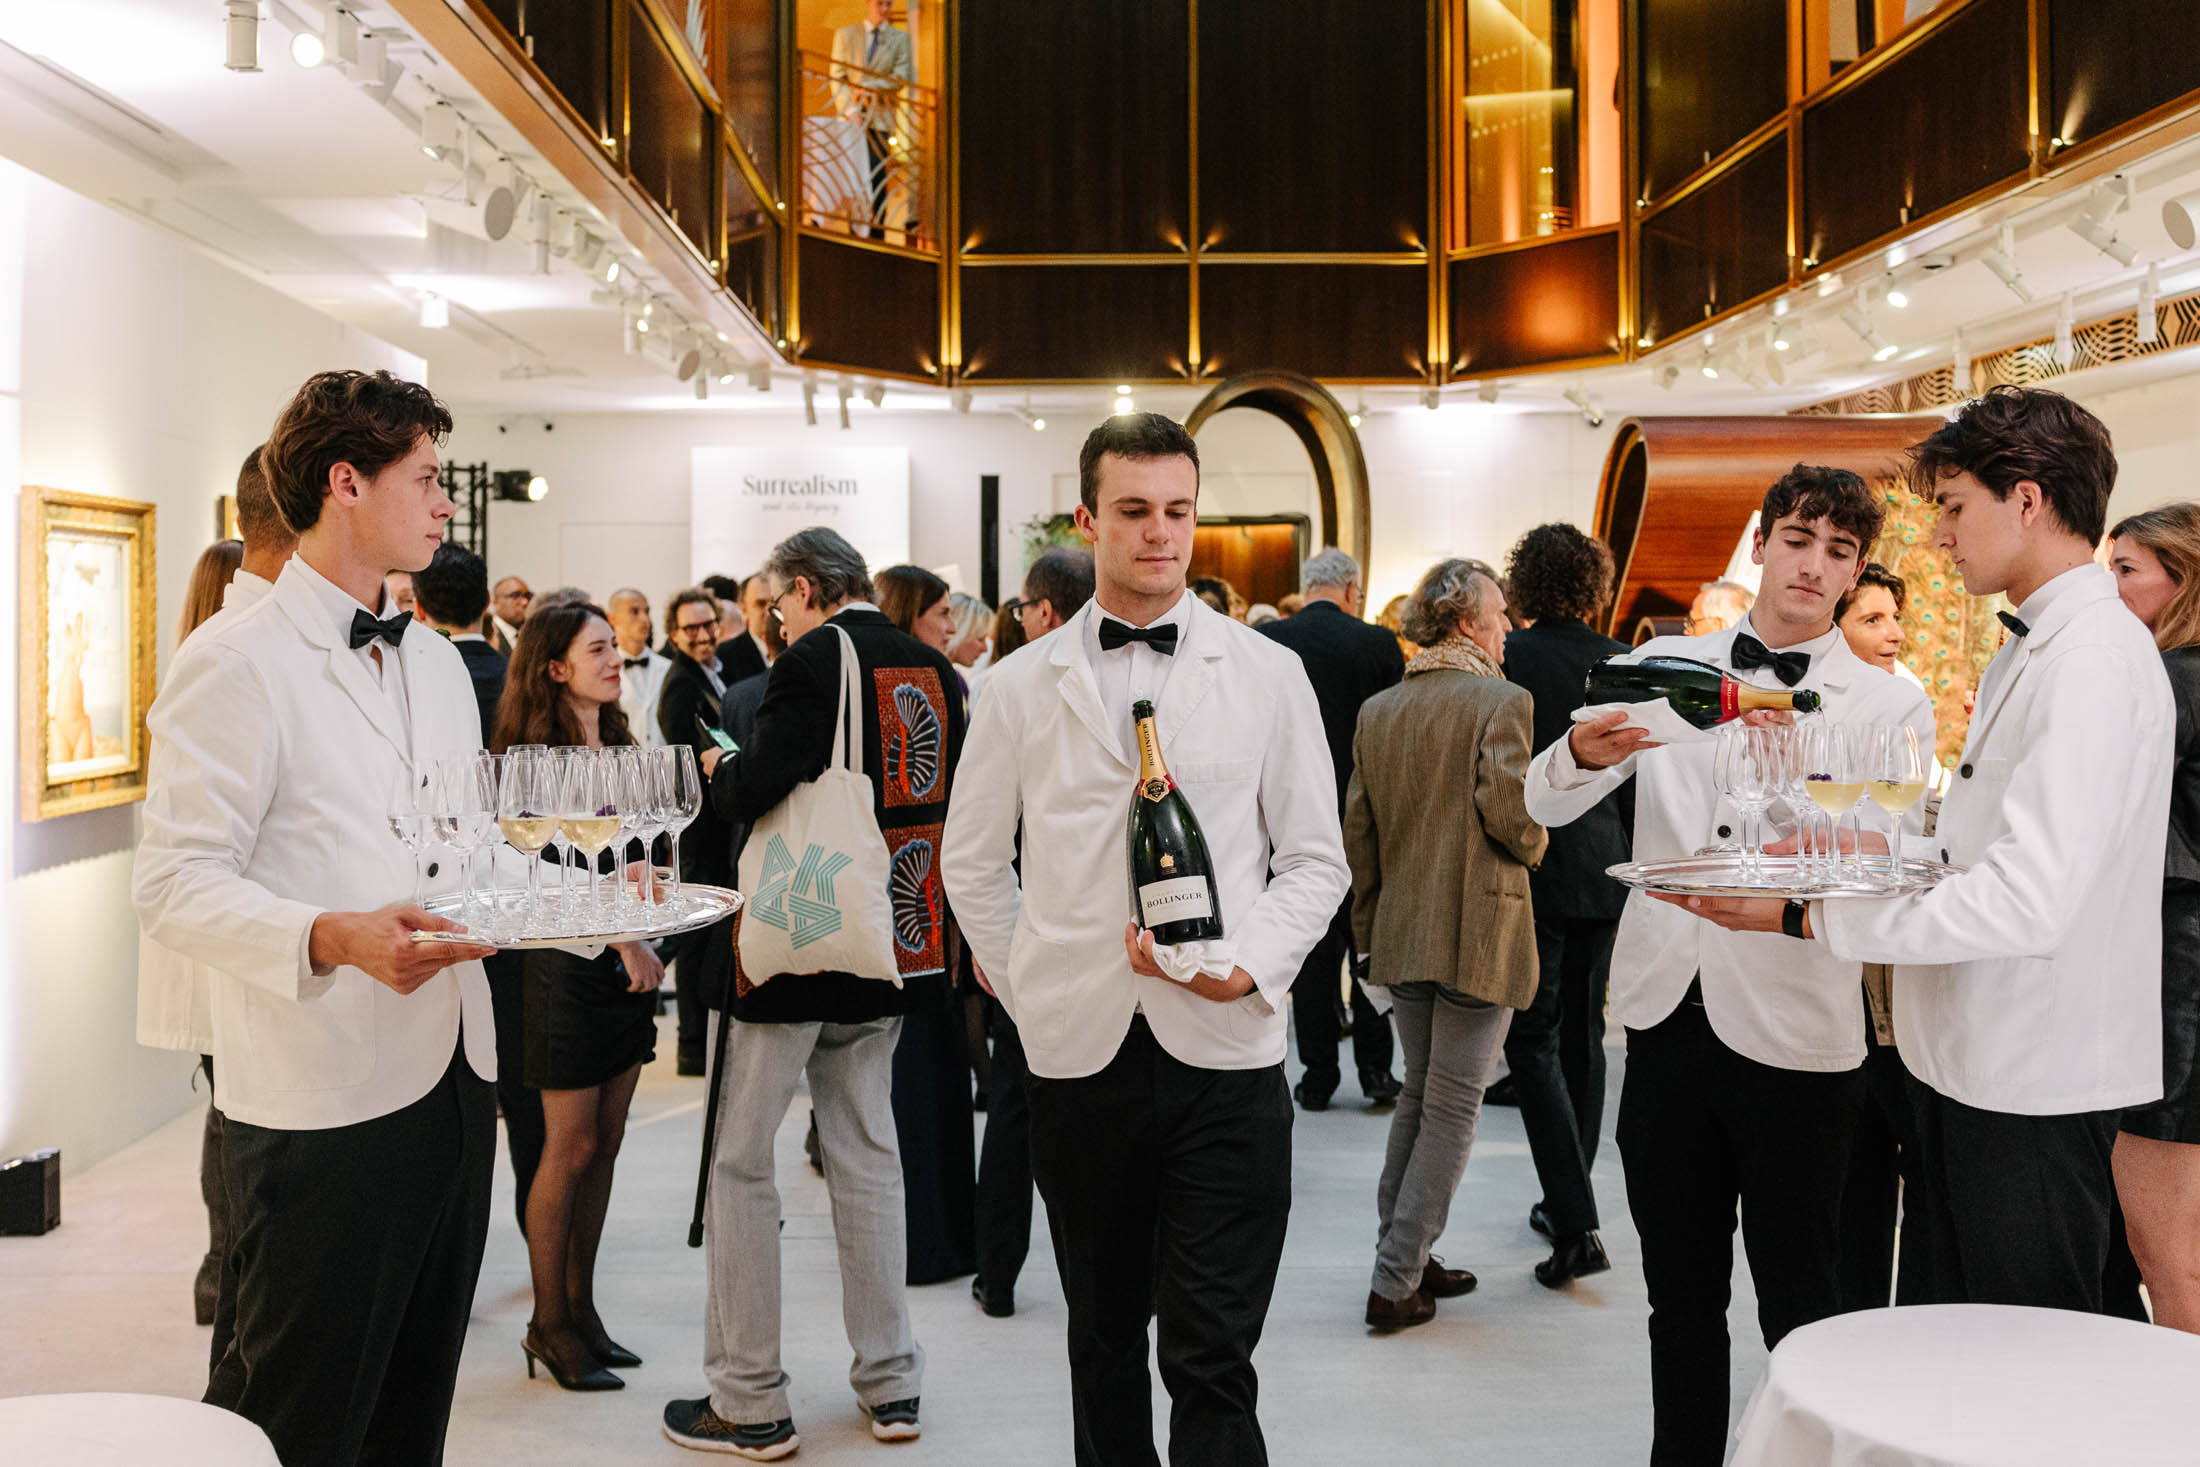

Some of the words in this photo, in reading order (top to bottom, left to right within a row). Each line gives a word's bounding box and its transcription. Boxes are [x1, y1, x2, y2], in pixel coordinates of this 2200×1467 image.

[741, 474, 859, 497] Surrealism
[1142, 723, 1155, 767] BOLLINGER
[1146, 890, 1203, 909] BOLLINGER
